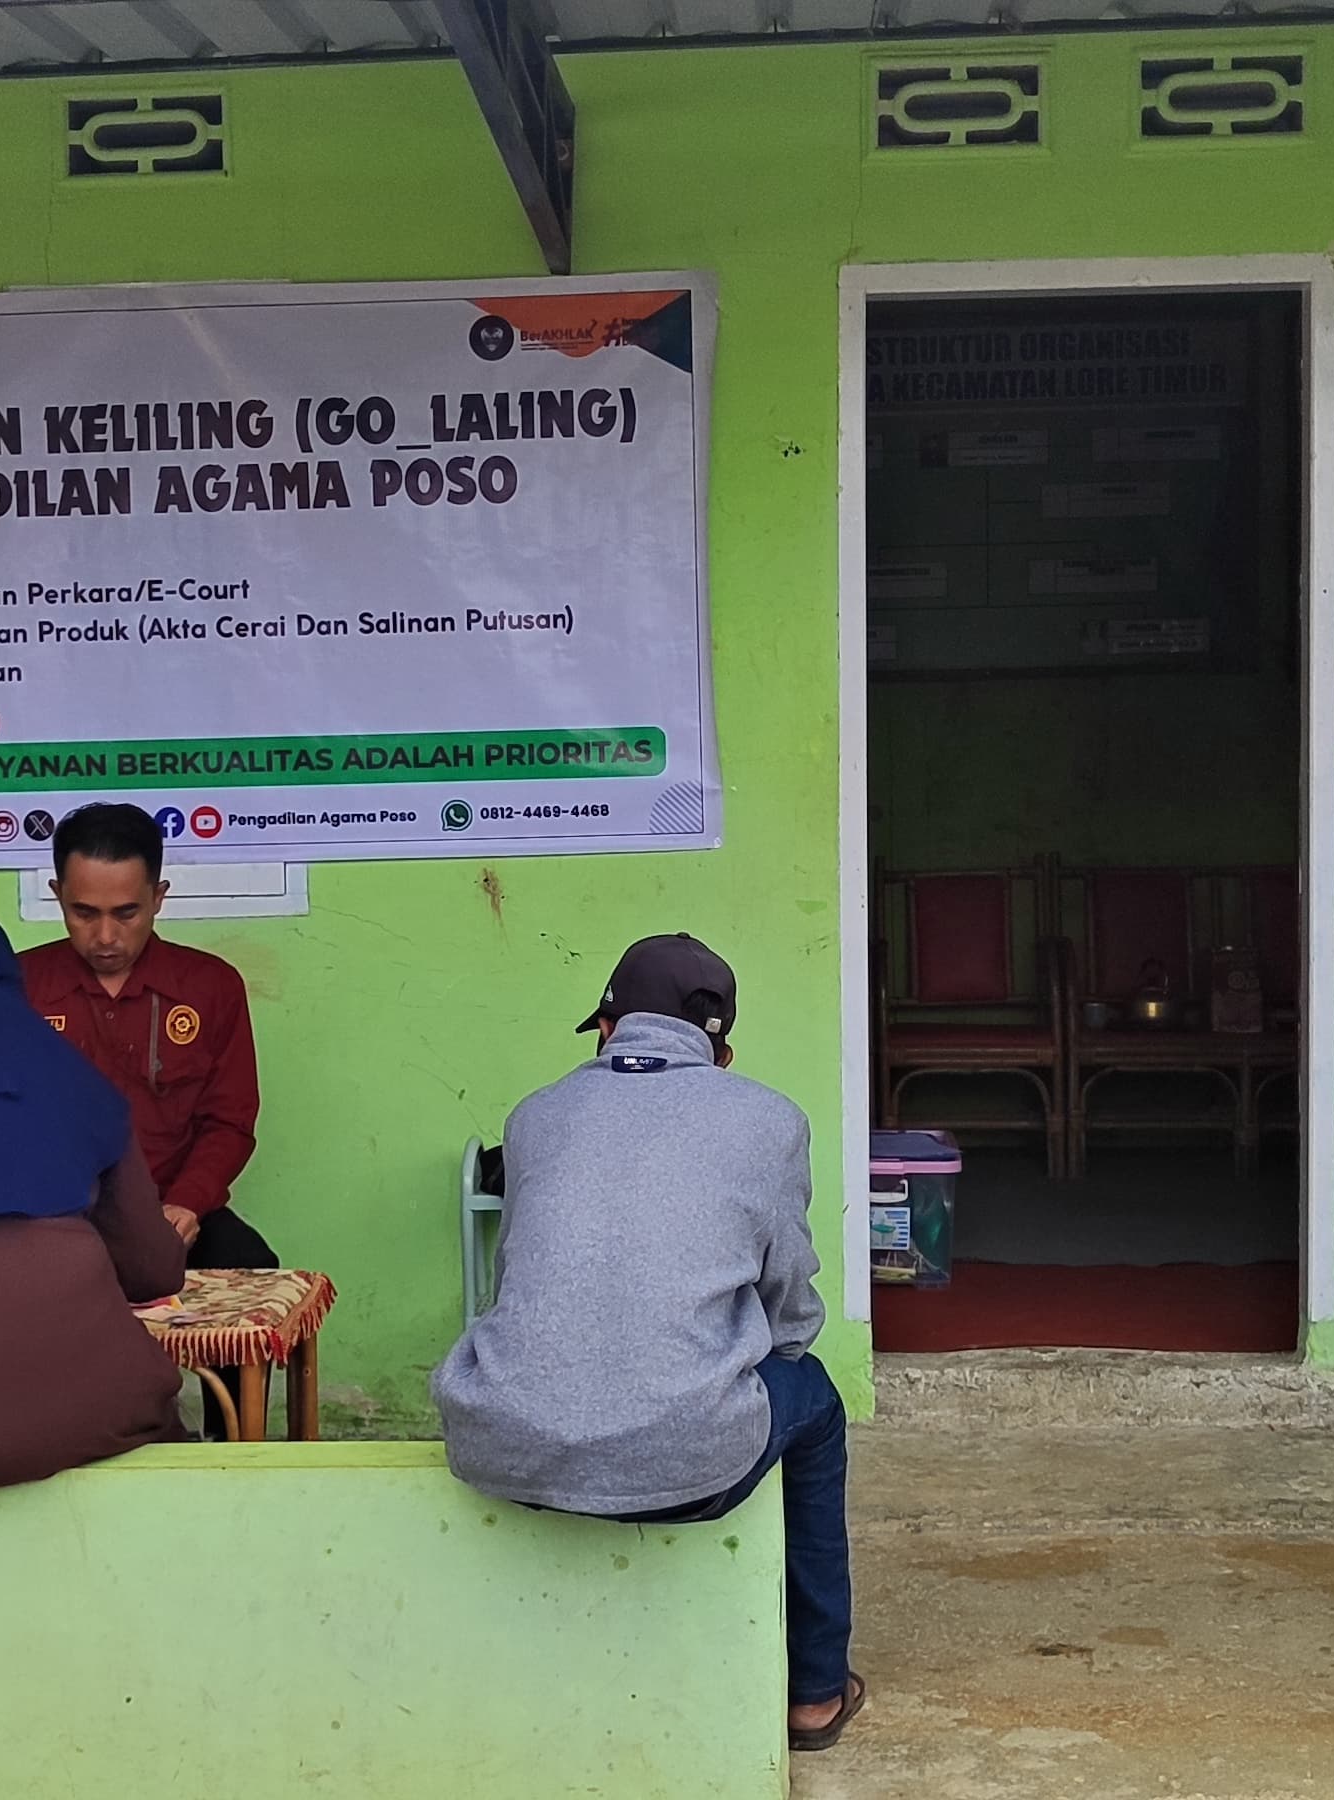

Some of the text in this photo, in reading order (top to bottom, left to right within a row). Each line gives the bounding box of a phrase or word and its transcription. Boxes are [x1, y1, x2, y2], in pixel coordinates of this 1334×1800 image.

[1019, 328, 1192, 361] ORGANISASI
[892, 368, 1057, 402] KECAMATAN
[1064, 365, 1130, 398] LORE
[1140, 362, 1228, 395] TIMUR
[43, 397, 275, 455] KELILING
[294, 386, 638, 454] (GO_LALING)
[154, 458, 352, 515] AGAMA
[370, 453, 519, 509] POSO
[26, 575, 252, 607] Perkara/E-Court
[38, 617, 130, 644] Produk
[138, 613, 207, 647] (Akta
[215, 615, 286, 639] Cerai
[296, 613, 349, 637] Dan
[358, 608, 456, 635] Salinan
[466, 604, 576, 636] Putusan)
[117, 747, 334, 778] BERKUALITAS
[342, 743, 475, 771] ADALAH
[485, 738, 654, 768] PRIORITAS
[227, 809, 317, 830] Pengadilan
[319, 808, 378, 828] Agama
[379, 806, 418, 824] Poso
[479, 803, 611, 821] 0812-4469-4468
